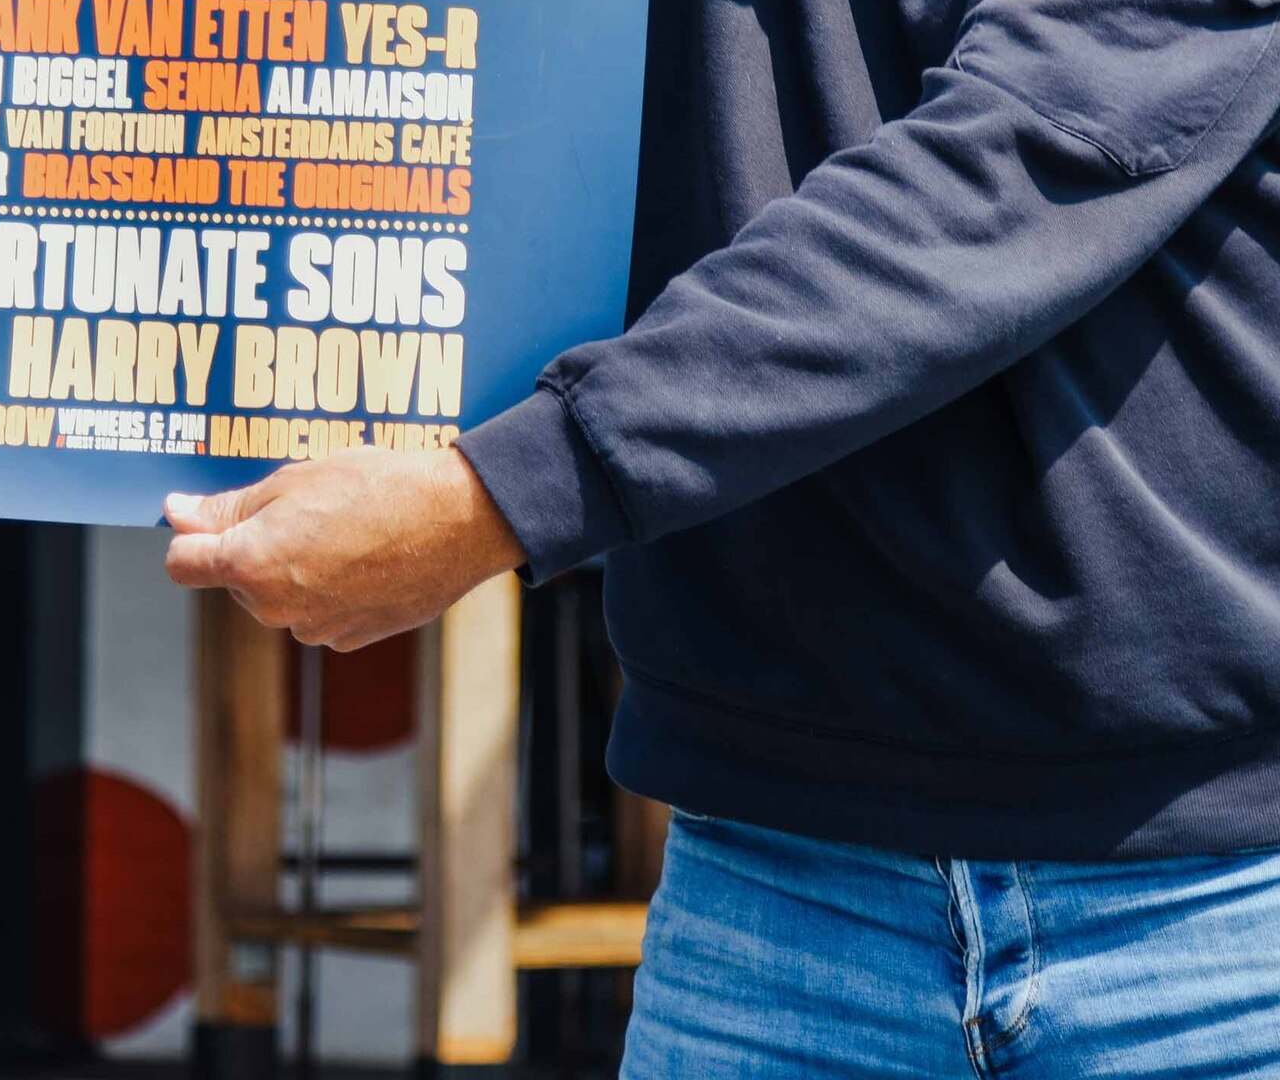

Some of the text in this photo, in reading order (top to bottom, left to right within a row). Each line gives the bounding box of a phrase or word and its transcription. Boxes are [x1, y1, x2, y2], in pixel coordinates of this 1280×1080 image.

[340, 2, 479, 69] YES-R
[12, 58, 133, 110] BIGGEL
[142, 61, 261, 113] SENNA
[266, 66, 474, 122] ALAMAISON
[6, 109, 65, 151] VAN
[69, 111, 185, 154] FORTUIN
[196, 116, 395, 163] AMSTERDAMS
[400, 118, 472, 166] CAFÉ
[22, 153, 220, 204] BRASSBAND
[228, 159, 286, 207] THE
[293, 162, 472, 216] ORIGINALS
[287, 232, 468, 327] SONS
[8, 316, 220, 406] HARRY
[233, 324, 464, 417] BROWN
[169, 412, 206, 441] PIM
[210, 415, 365, 460] HARDCORE
